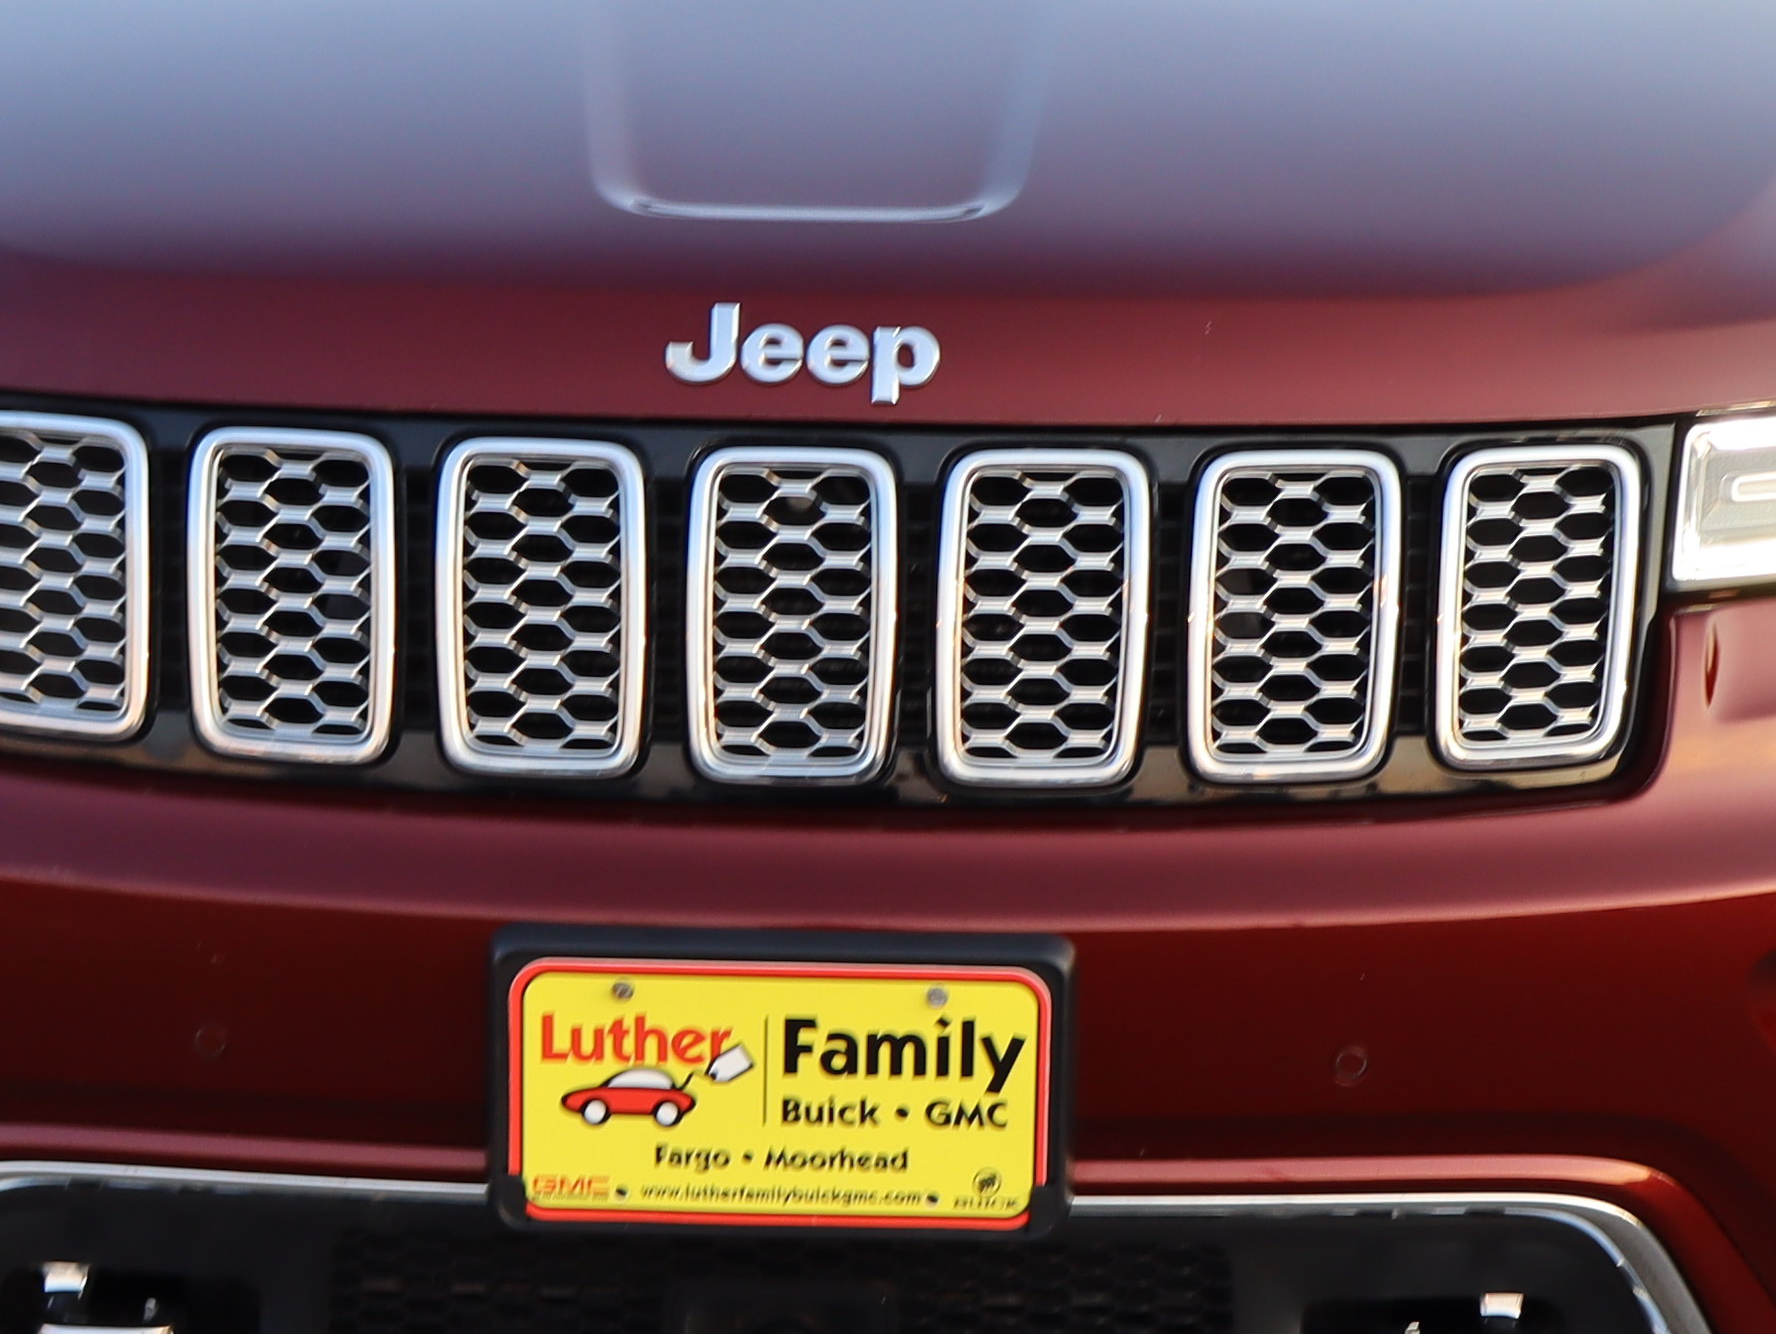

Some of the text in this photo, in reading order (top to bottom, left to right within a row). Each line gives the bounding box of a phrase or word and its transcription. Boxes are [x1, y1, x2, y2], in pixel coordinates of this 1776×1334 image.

[665, 301, 941, 405] Jeep
[540, 1013, 1027, 1095] Luther Family
[781, 1095, 1009, 1129] Buick GMC
[654, 1143, 910, 1174] Fargo Moorhead
[532, 1175, 611, 1197] GMC
